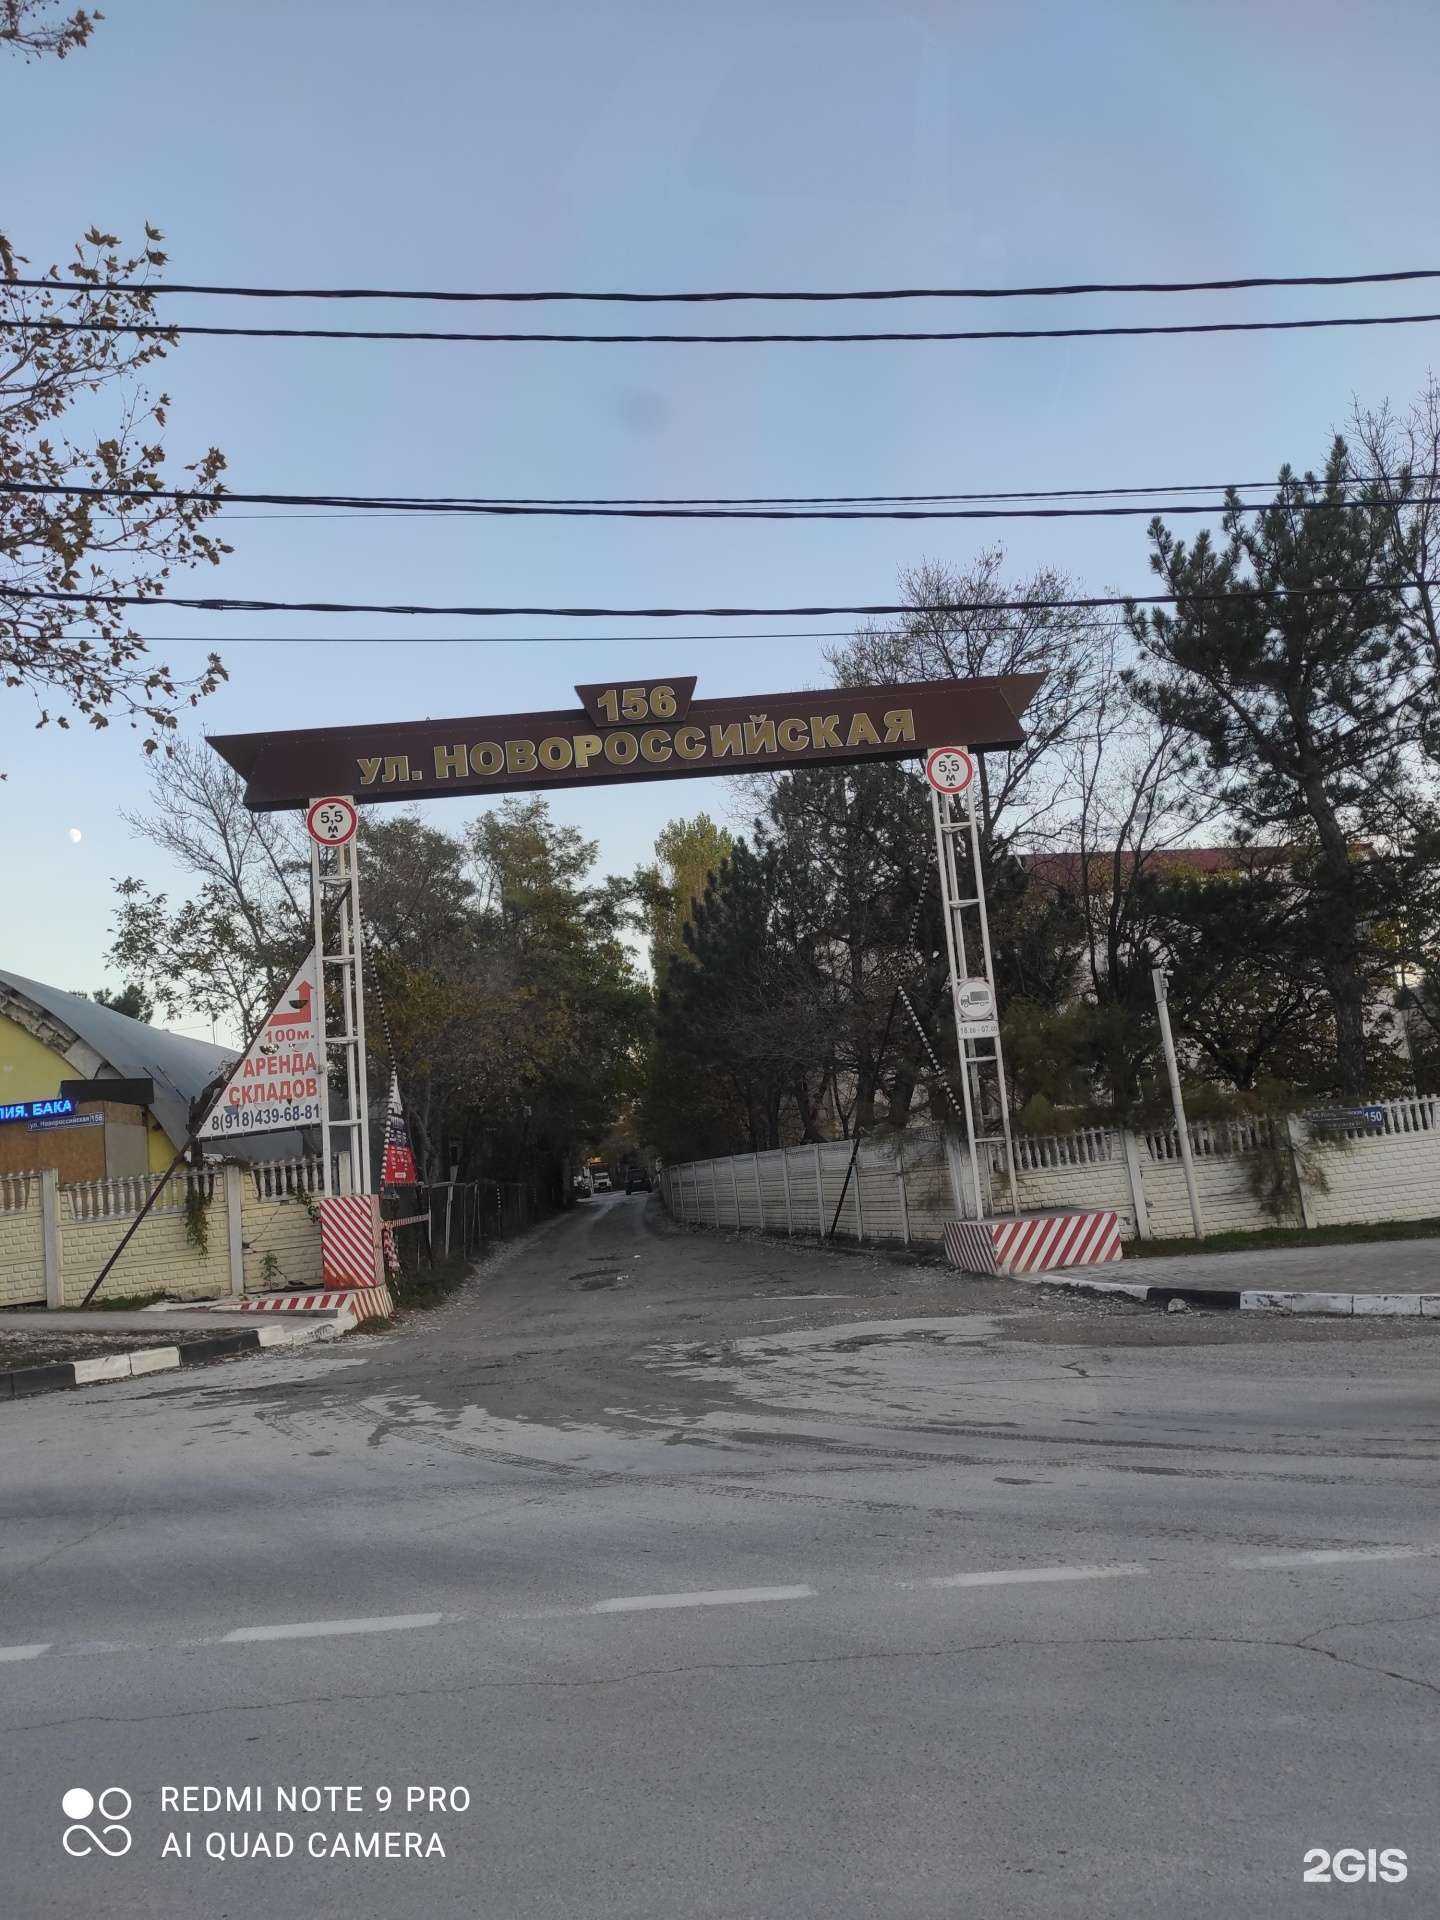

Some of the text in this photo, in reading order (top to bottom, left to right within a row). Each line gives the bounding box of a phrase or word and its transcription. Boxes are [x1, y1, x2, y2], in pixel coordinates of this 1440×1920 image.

[597, 685, 677, 721] 156
[433, 708, 917, 780] НОВОРОССИЙСКАЯ
[938, 760, 960, 774] 5,5
[320, 810, 343, 825] 5,5
[243, 1051, 317, 1078] АРЕНДА
[228, 1077, 318, 1106] СКЛАДОВ
[32, 1099, 72, 1116] БАКА
[212, 1103, 320, 1132] 8(918)439-68-81
[1364, 1111, 1382, 1122] 150
